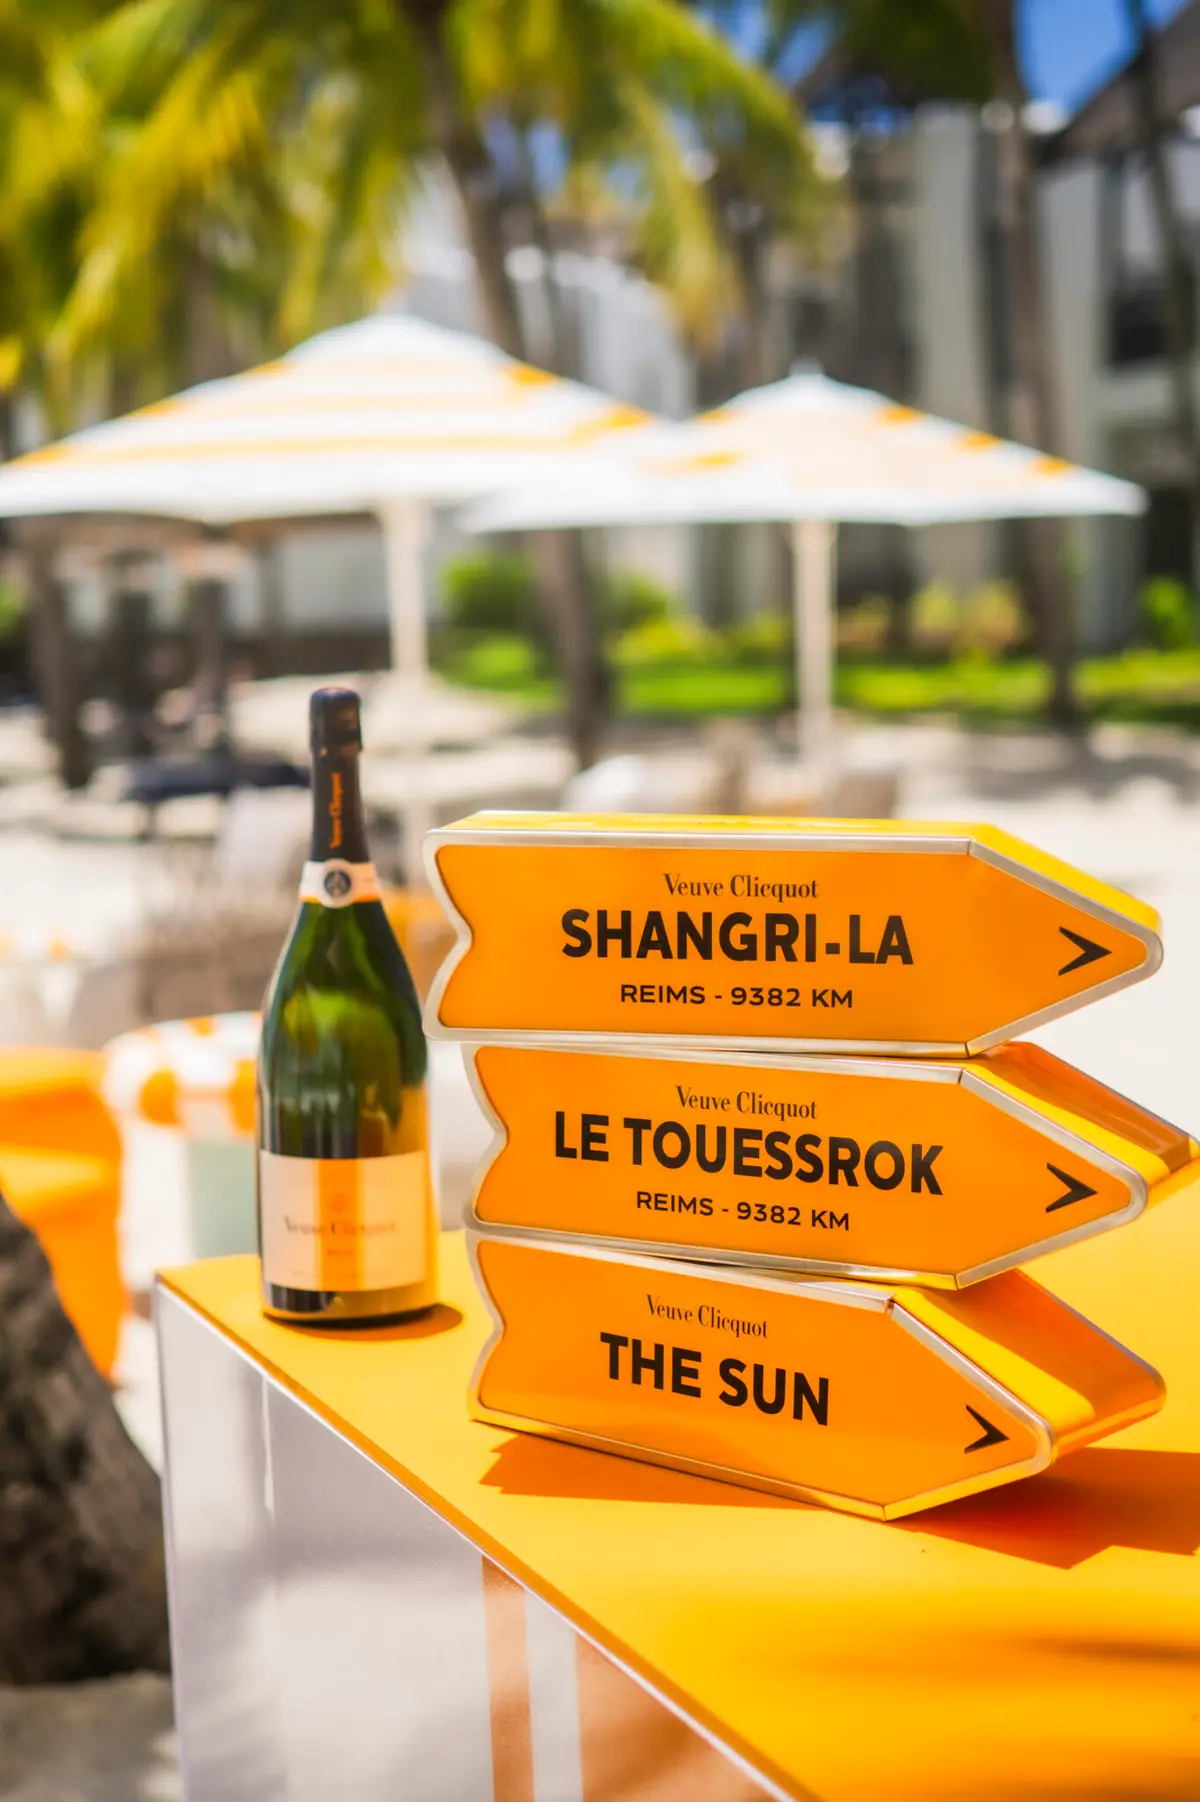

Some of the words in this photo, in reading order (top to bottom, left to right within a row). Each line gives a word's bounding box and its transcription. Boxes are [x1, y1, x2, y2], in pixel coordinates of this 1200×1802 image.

[663, 873, 724, 898] Veuve
[730, 874, 819, 903] Clicquot
[561, 908, 914, 966] SHANGRI-LA
[620, 984, 706, 1005] REIMS
[730, 986, 801, 1008] 9382
[811, 988, 853, 1009] KM
[675, 1085, 731, 1112] Veuve
[736, 1090, 818, 1122] Clicquot
[555, 1111, 610, 1163] LE
[623, 1117, 944, 1196] TOUESSROK
[636, 1190, 714, 1217] REIMS
[736, 1201, 801, 1227] 9382
[811, 1209, 850, 1231] KM
[646, 1294, 693, 1323] Veuve
[697, 1304, 768, 1339] Clicquot
[599, 1331, 702, 1399] THE
[718, 1357, 829, 1427] SUN
